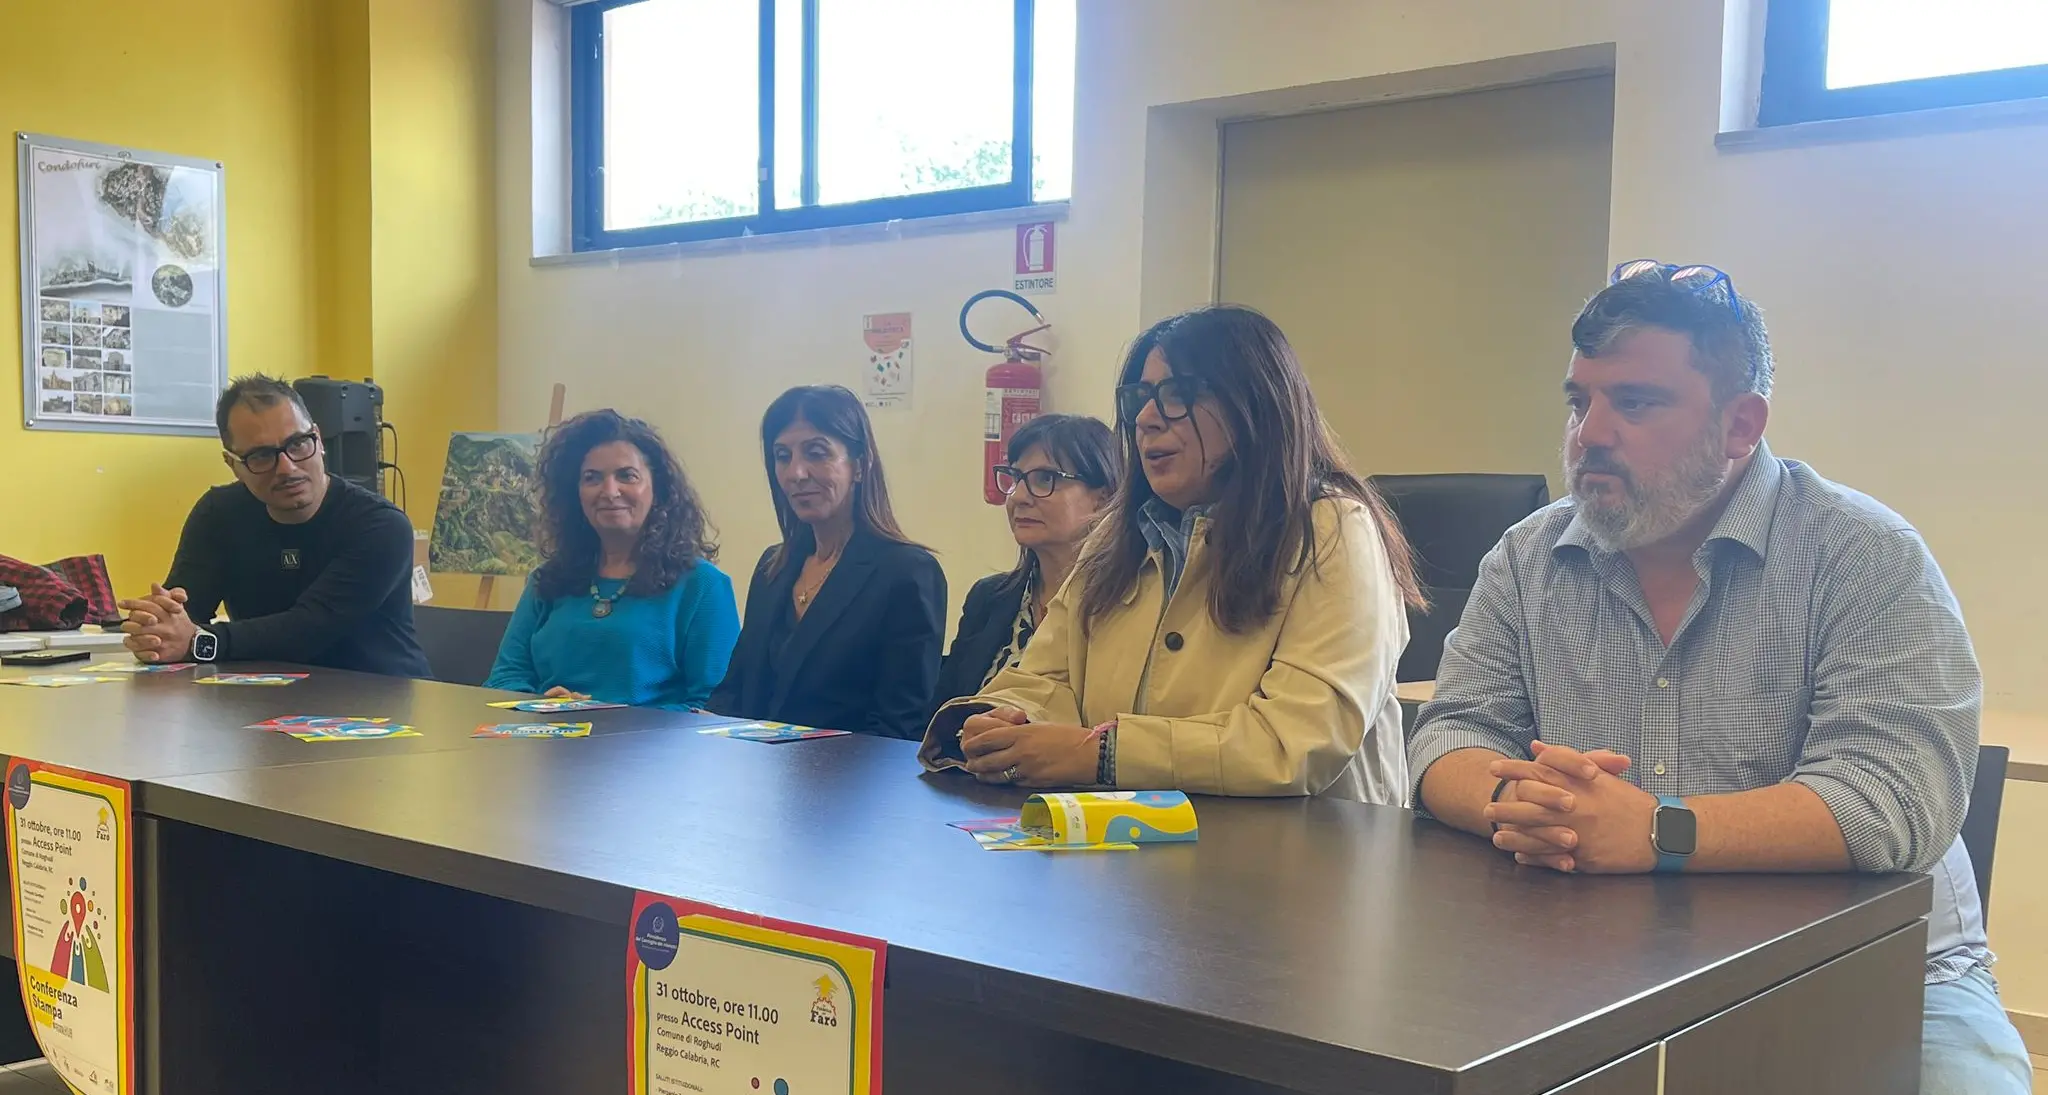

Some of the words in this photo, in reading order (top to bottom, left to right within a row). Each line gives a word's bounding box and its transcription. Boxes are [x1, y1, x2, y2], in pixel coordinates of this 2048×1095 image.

[1015, 277, 1054, 290] ESTINTORE
[20, 817, 26, 828] 31
[27, 821, 53, 836] ottobre,
[53, 827, 65, 838] ore
[66, 828, 81, 842] 11.00
[32, 836, 54, 851] Access
[55, 842, 72, 856] Point
[30, 975, 78, 1007] Conferenza
[656, 982, 668, 998] 31
[671, 987, 720, 1013] ottobre,
[723, 1000, 745, 1016] ore
[748, 1003, 779, 1025] 11.00
[32, 994, 63, 1020] Stampa
[656, 1012, 679, 1024] presso
[681, 1011, 722, 1035] Access
[726, 1022, 760, 1045] Point
[656, 1027, 685, 1043] Comune
[685, 1034, 693, 1043] di
[693, 1036, 722, 1052] Roghudi
[656, 1043, 679, 1058] Reggio
[680, 1049, 709, 1067] Calabria,
[710, 1058, 721, 1069] RC
